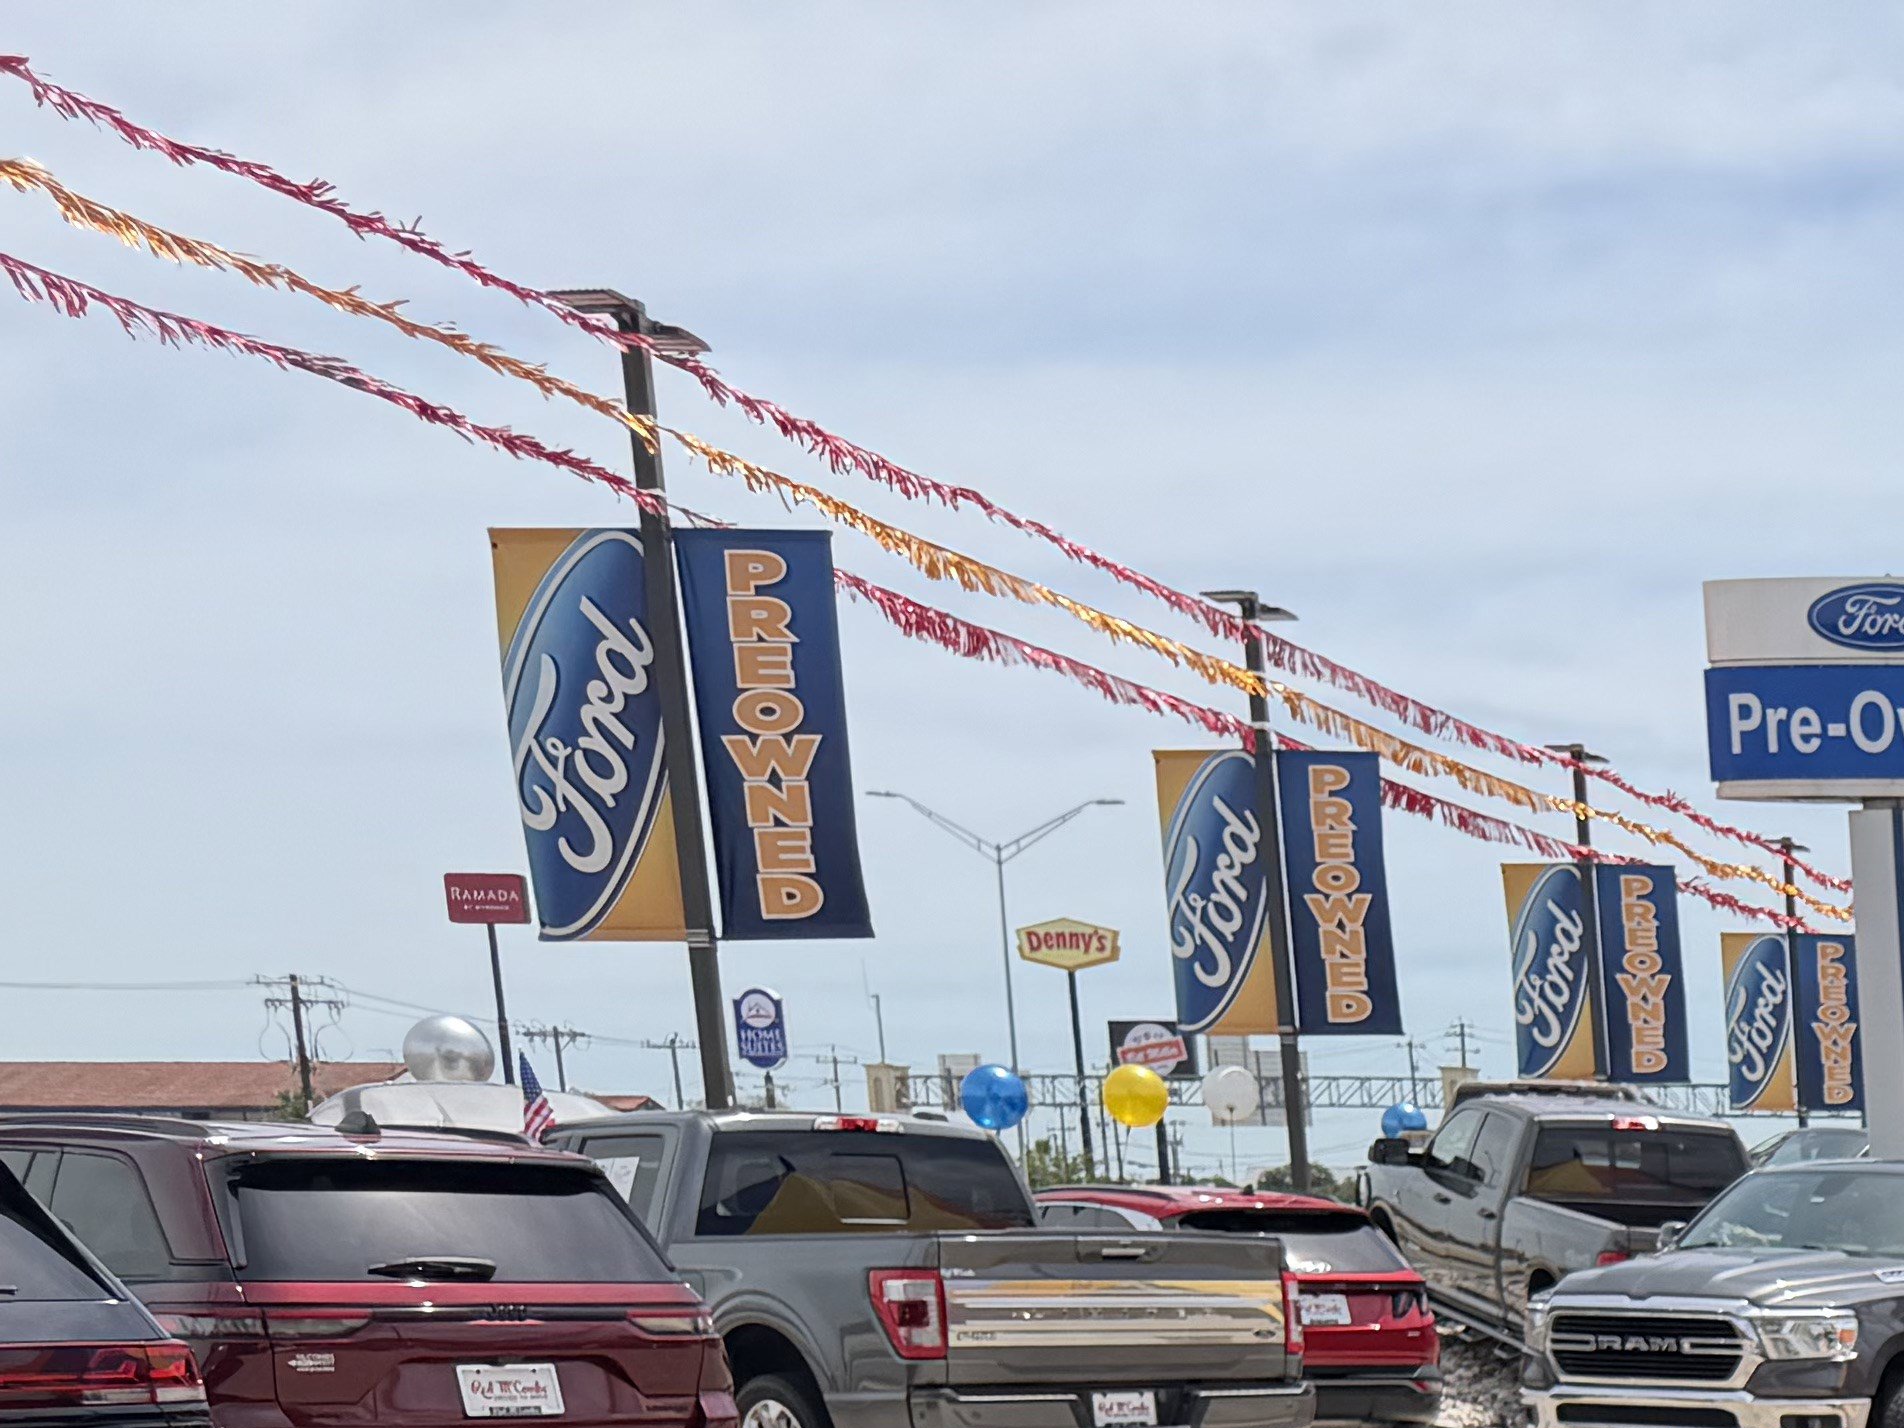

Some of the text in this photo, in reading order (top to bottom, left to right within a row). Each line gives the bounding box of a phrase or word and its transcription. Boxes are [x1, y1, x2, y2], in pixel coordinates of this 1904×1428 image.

[514, 595, 655, 874] Ford
[720, 549, 824, 920] PREOWNED
[1025, 928, 1108, 954] Denny's
[1170, 795, 1261, 988] Ford
[1303, 764, 1373, 1023] PREOWNED
[1514, 899, 1584, 1048] Ford
[1615, 874, 1671, 1075] PREOWNED
[1728, 961, 1787, 1083] Ford
[1810, 941, 1857, 1105] PREOWNED
[1598, 1335, 1677, 1352] RAM
